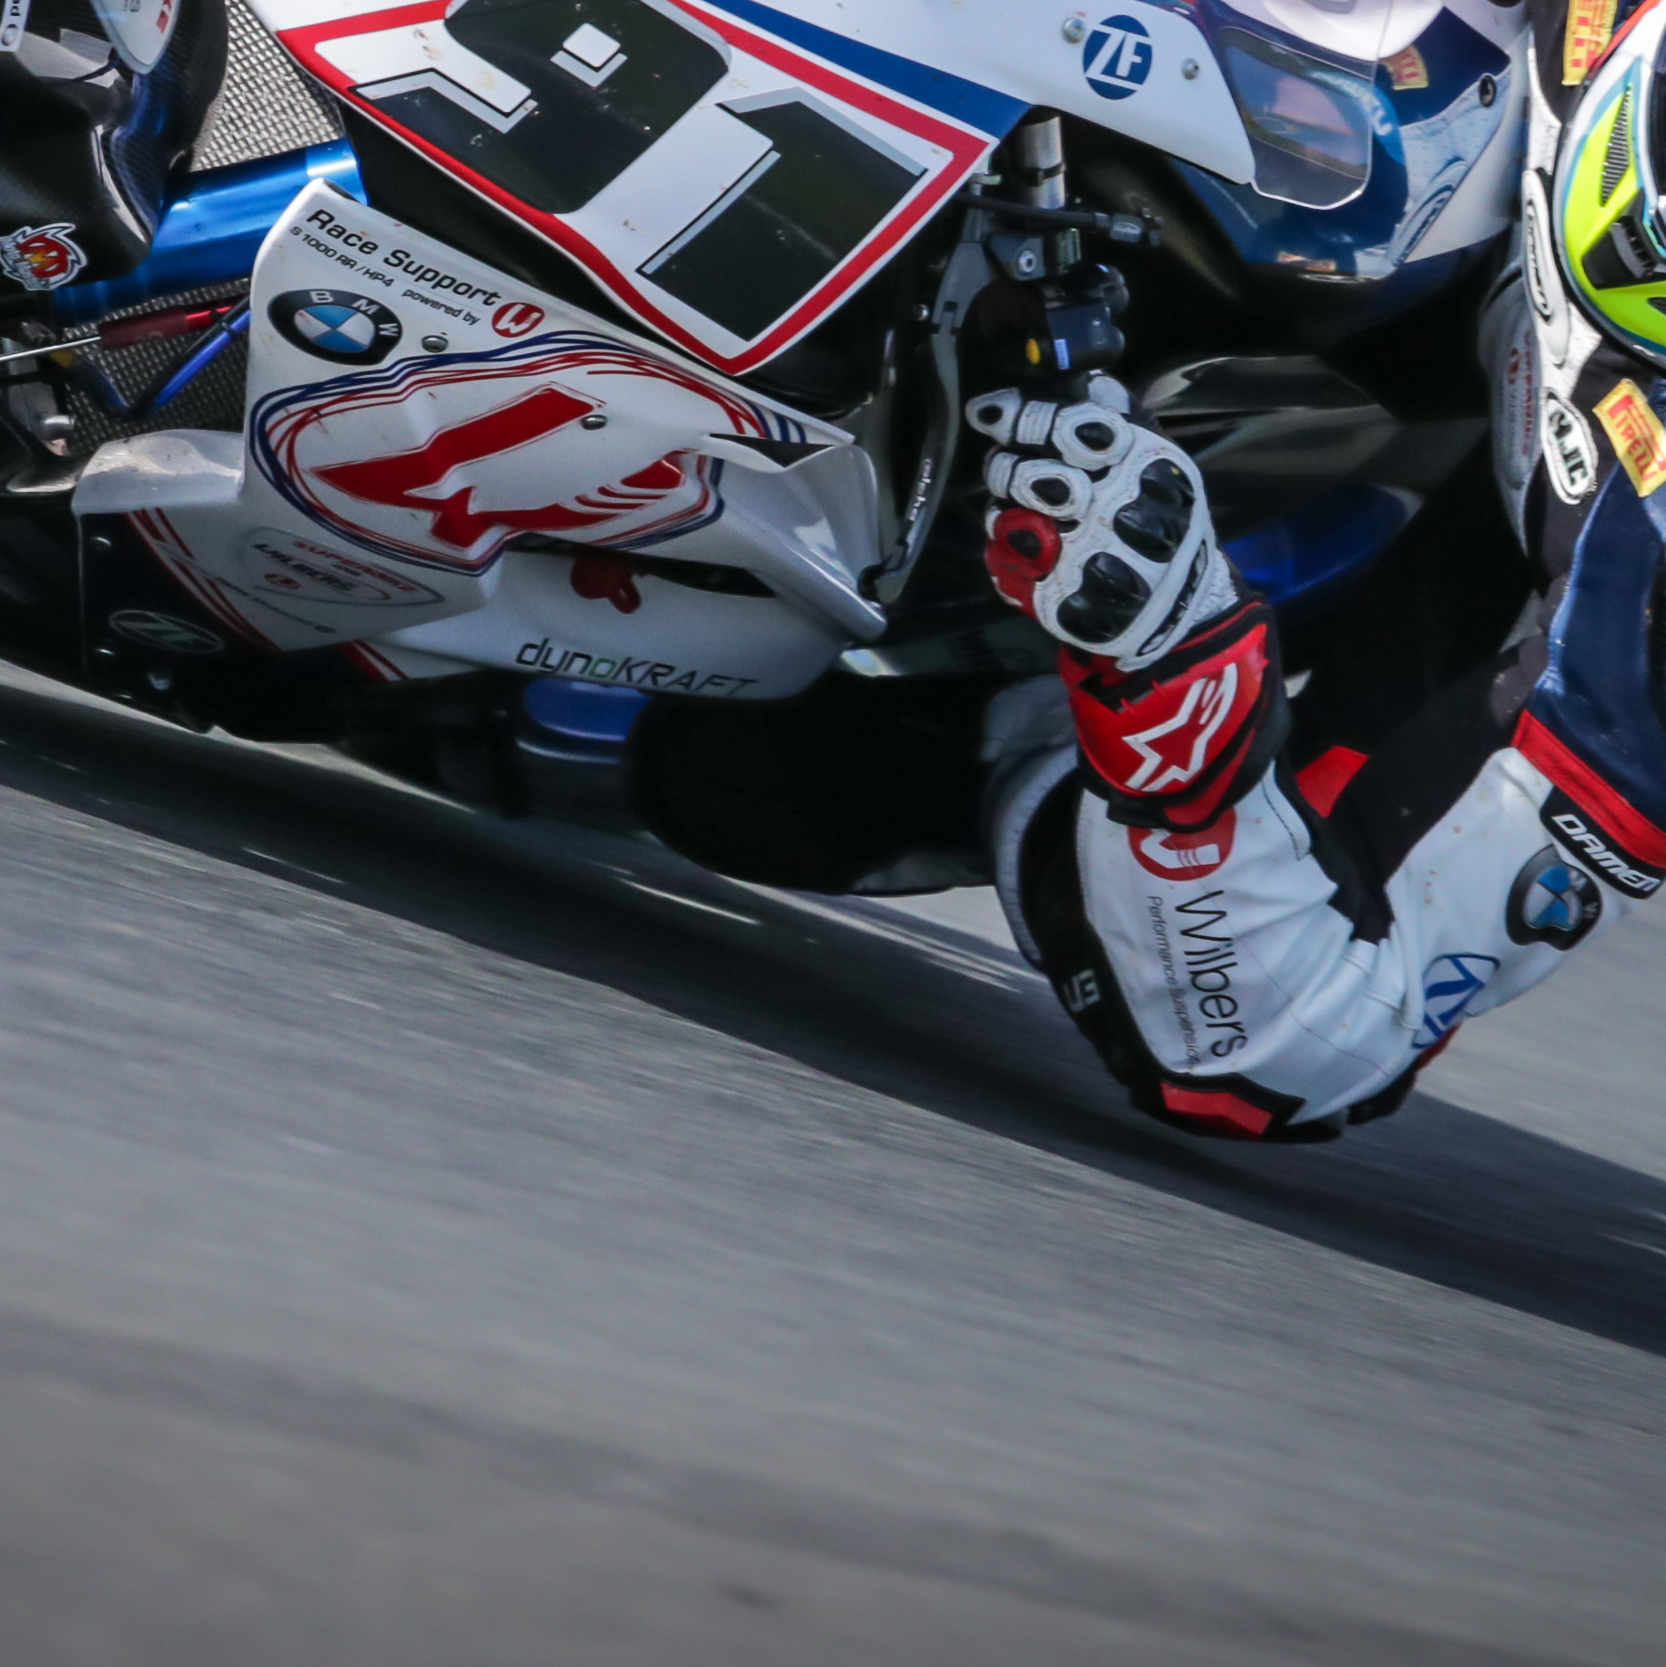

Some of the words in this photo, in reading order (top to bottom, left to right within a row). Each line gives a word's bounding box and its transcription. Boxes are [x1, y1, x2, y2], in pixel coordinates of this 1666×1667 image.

[1084, 17, 1153, 92] ZF
[302, 233, 337, 259] 1000
[306, 209, 379, 256] Race
[383, 248, 503, 307] Support
[310, 290, 400, 337] BMW
[401, 288, 464, 318] powered
[461, 310, 482, 326] by
[515, 636, 762, 696] dynoKRAFT
[1146, 894, 1179, 992] Performance
[1175, 889, 1249, 1059] Wilbers
